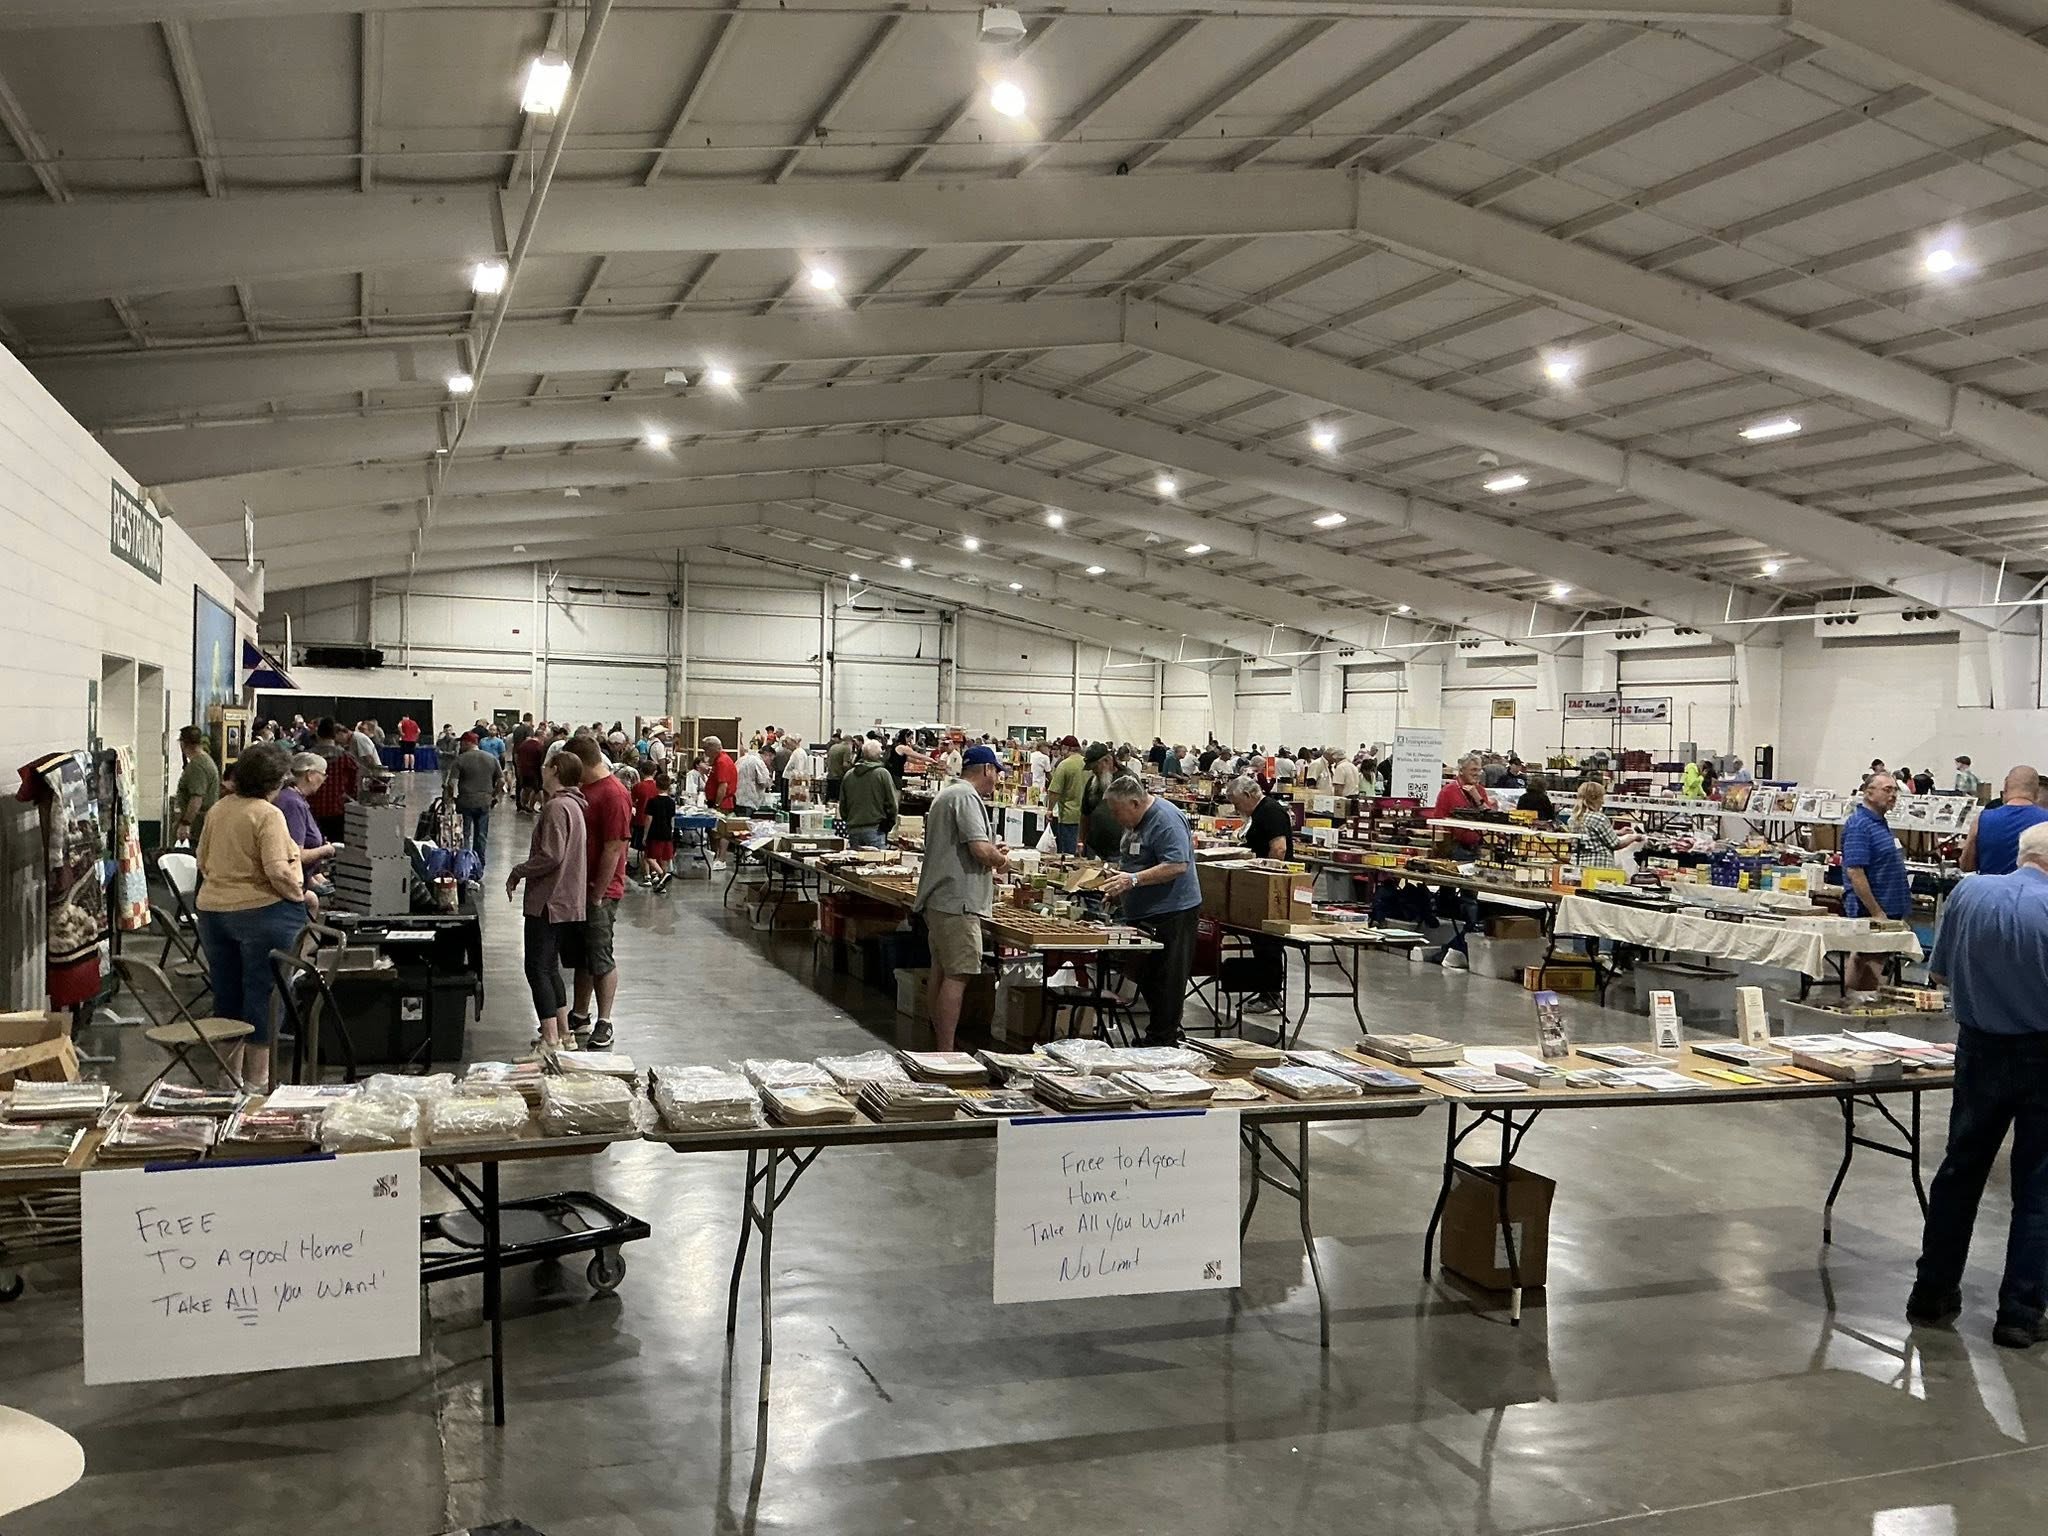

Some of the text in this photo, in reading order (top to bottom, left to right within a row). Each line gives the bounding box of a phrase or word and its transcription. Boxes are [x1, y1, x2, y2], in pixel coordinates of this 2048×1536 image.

[113, 487, 161, 574] RESTROOMS
[136, 1207, 216, 1242] FREE
[1078, 1213, 1099, 1234] All
[240, 1241, 287, 1277] good
[1059, 1245, 1140, 1281] No Limit
